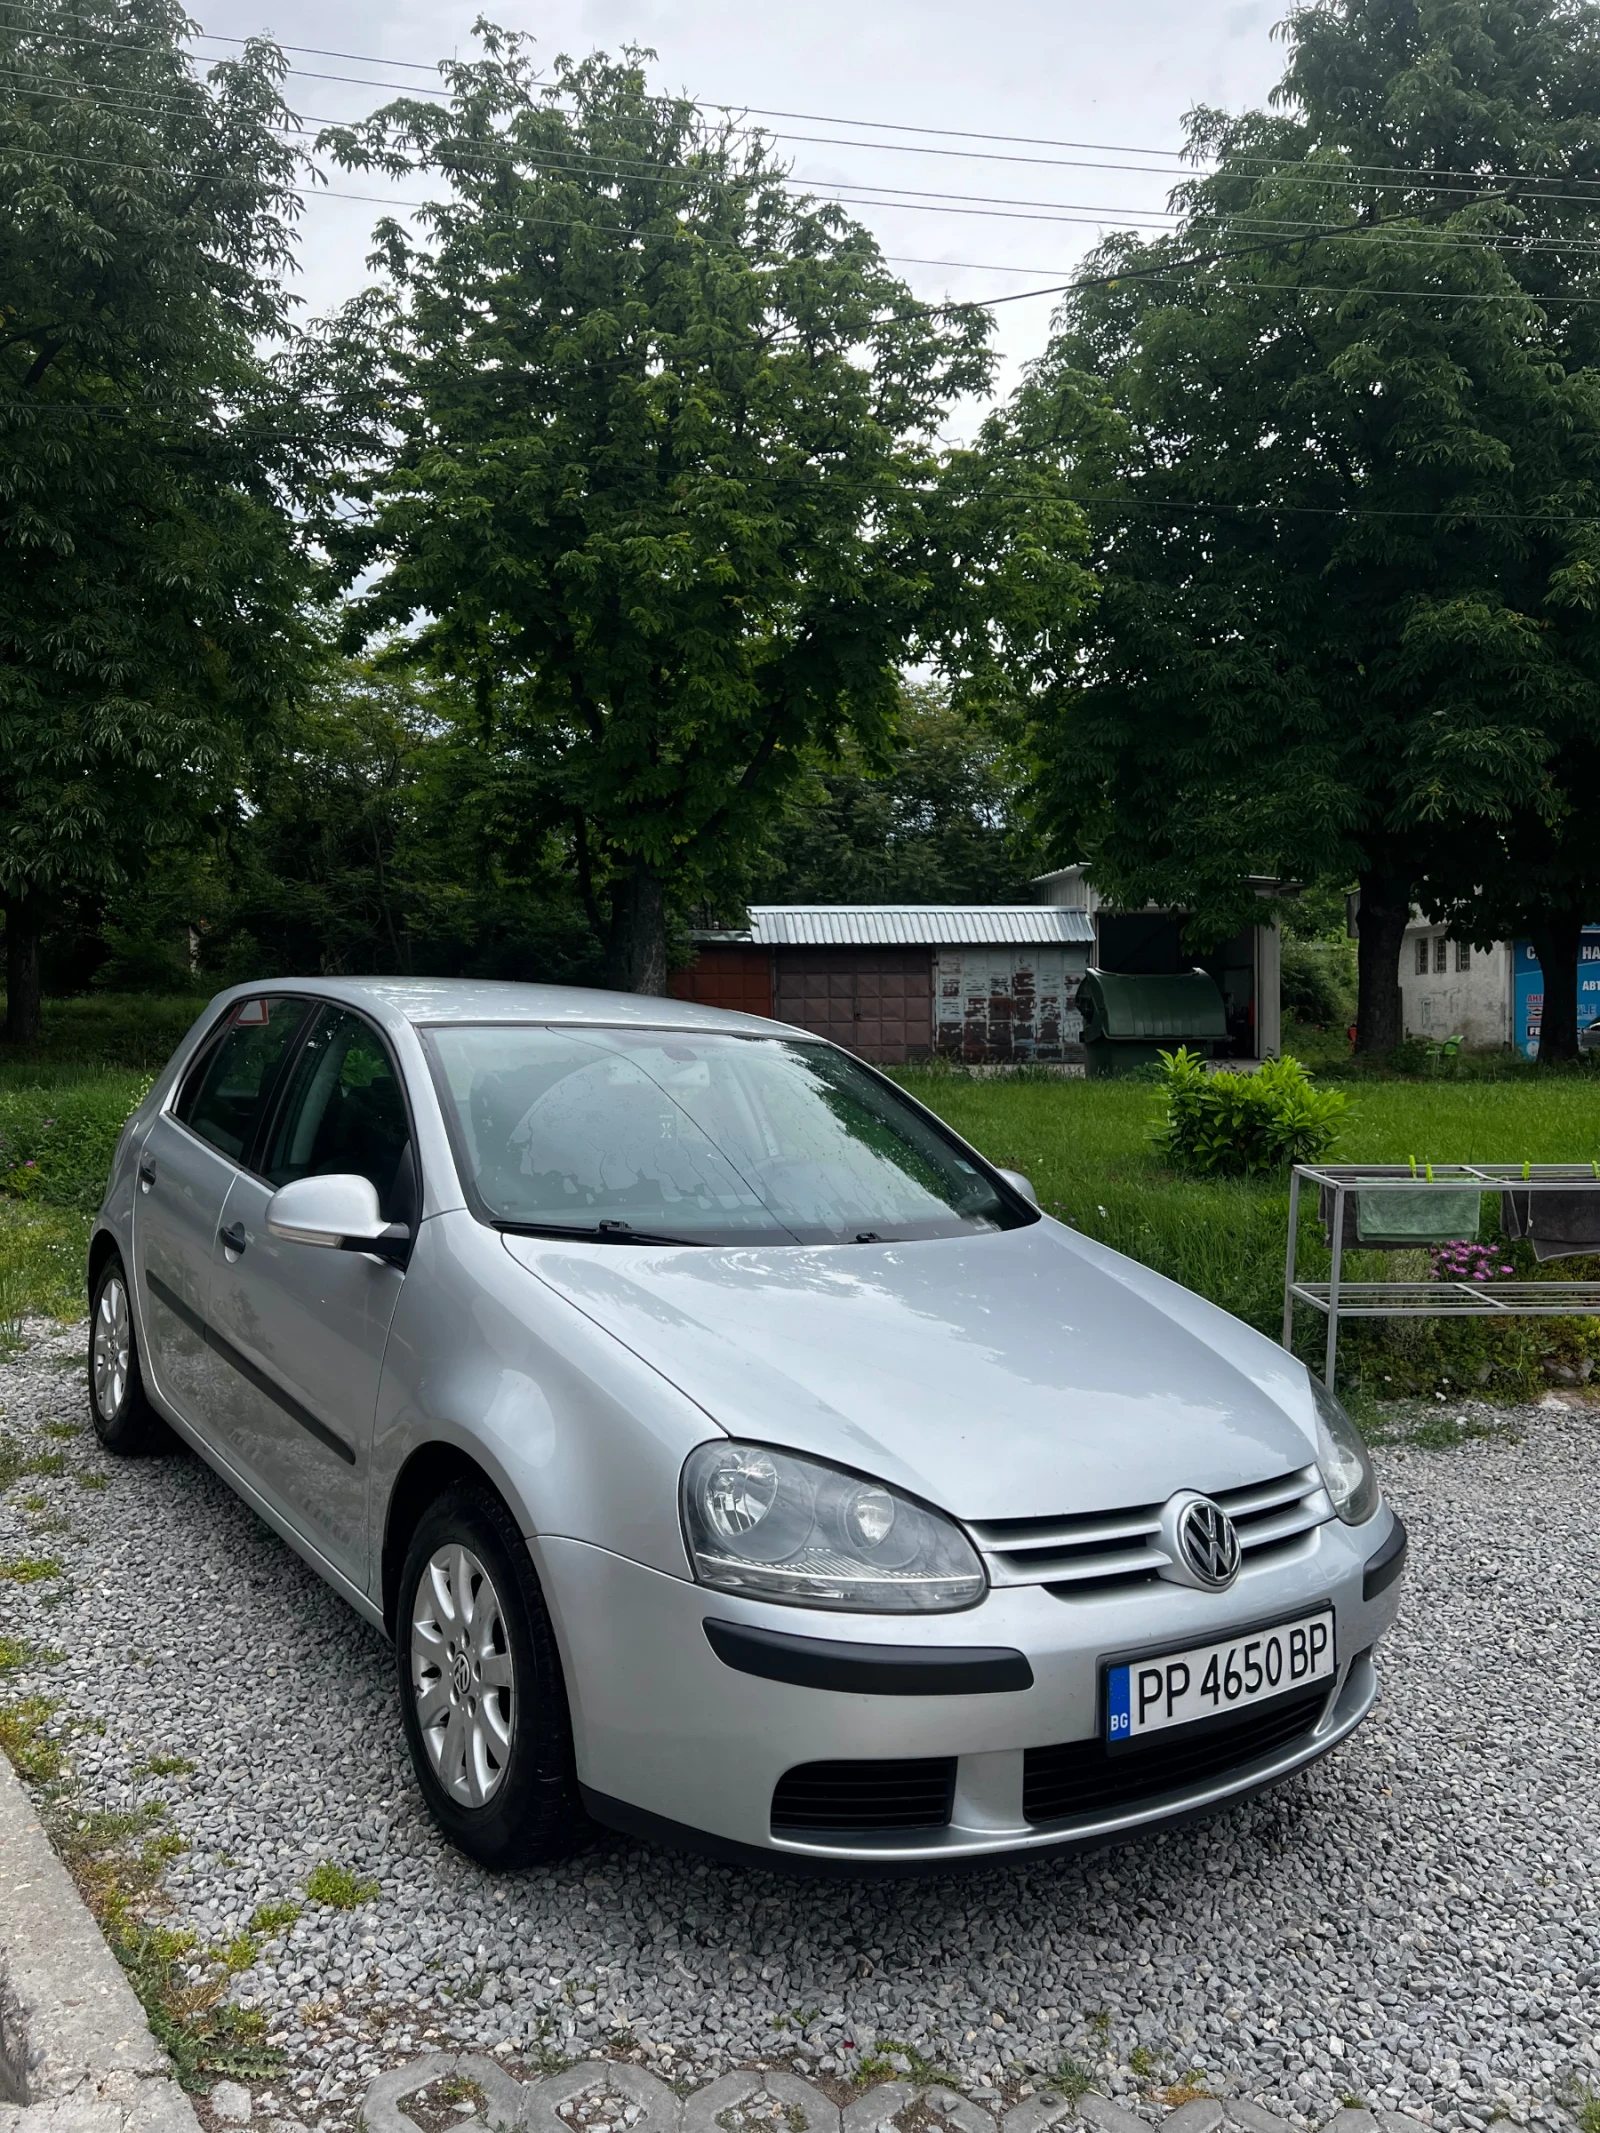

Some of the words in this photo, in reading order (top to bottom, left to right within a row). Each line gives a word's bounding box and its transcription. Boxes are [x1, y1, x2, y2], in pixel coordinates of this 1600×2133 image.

[1138, 1662, 1190, 1725] PP
[1200, 1636, 1283, 1706] 4650
[1289, 1622, 1328, 1680] BP
[1110, 1712, 1129, 1732] BG
